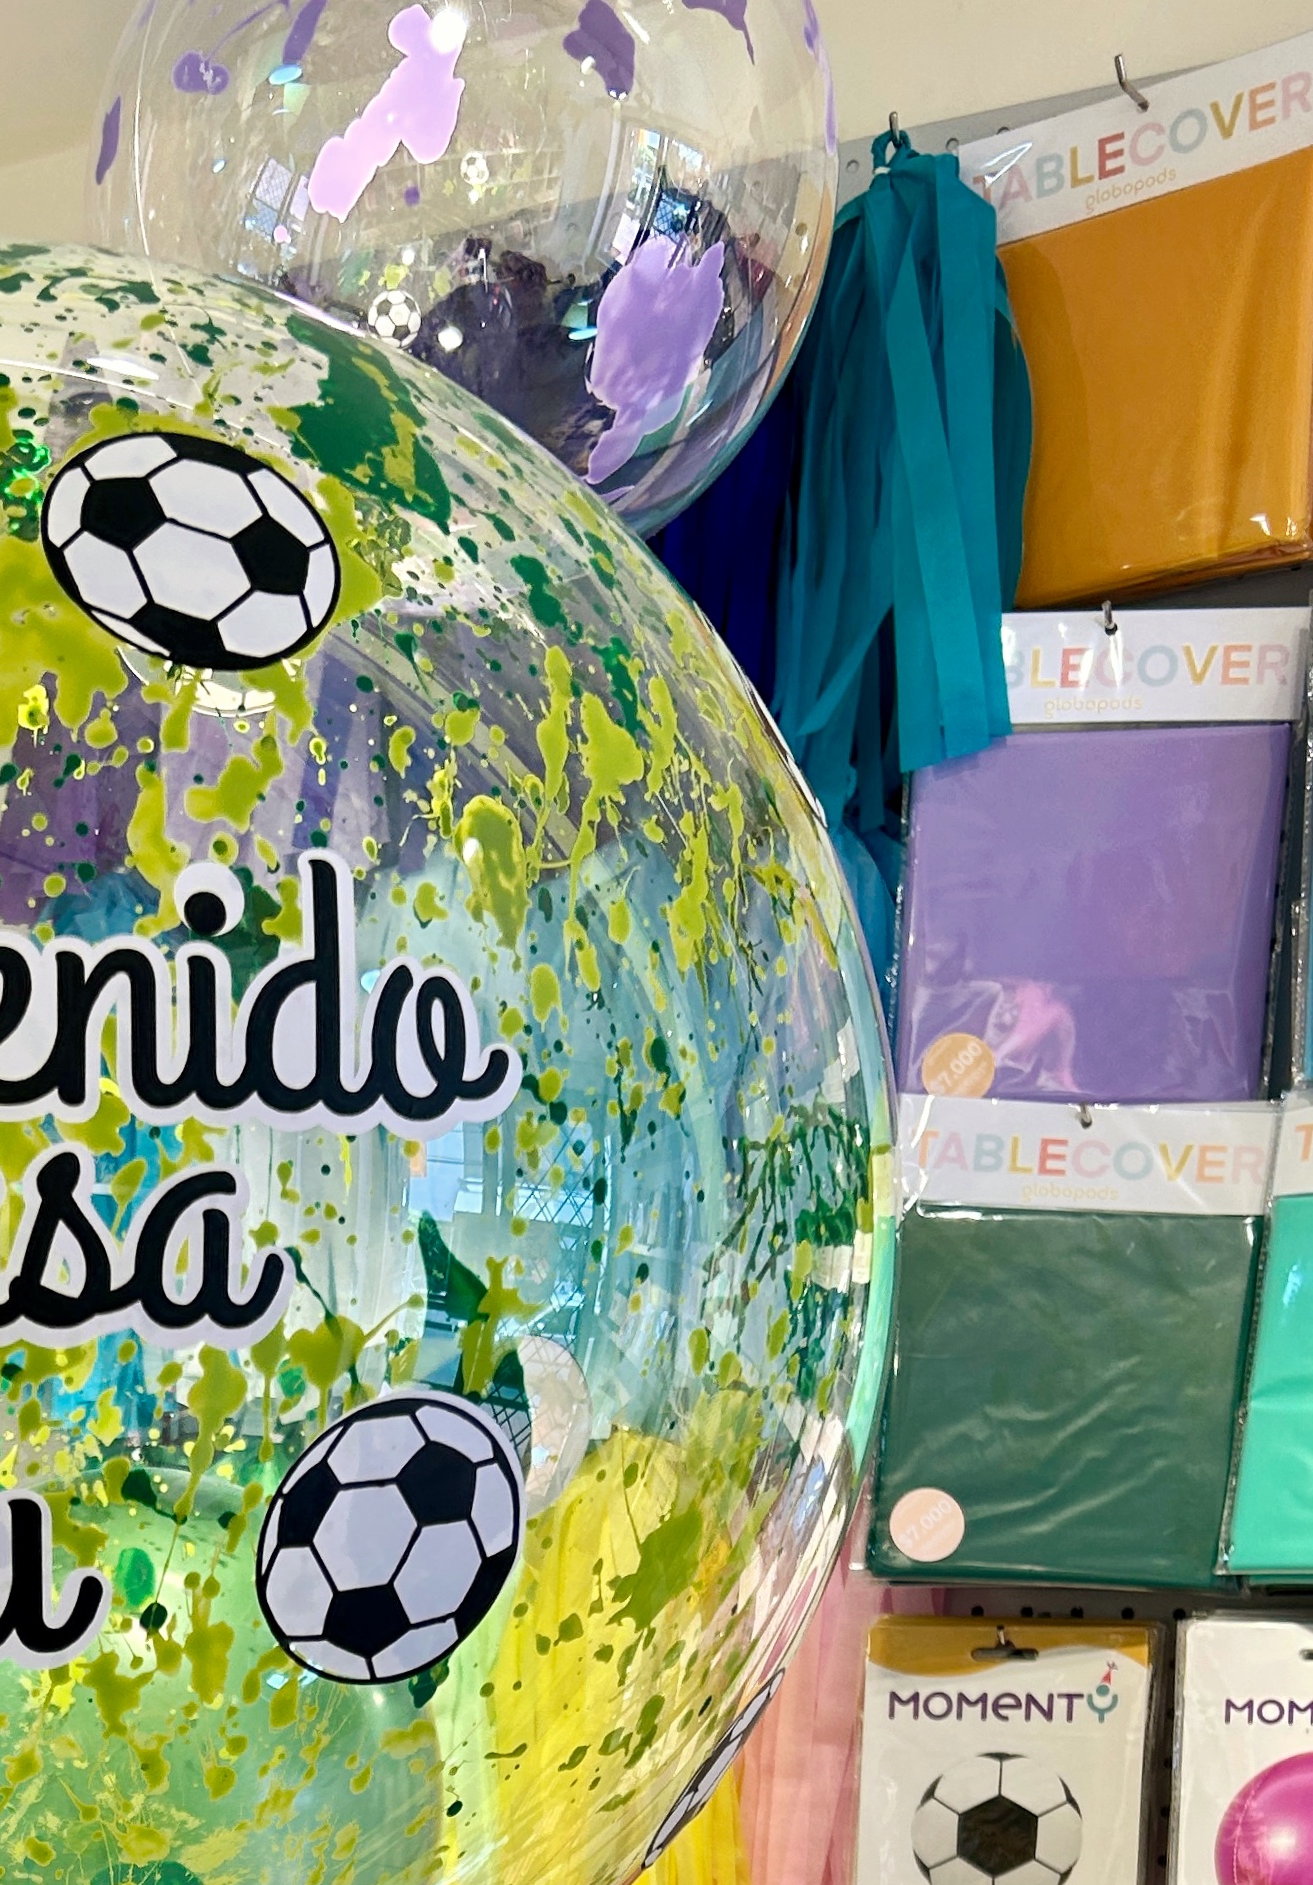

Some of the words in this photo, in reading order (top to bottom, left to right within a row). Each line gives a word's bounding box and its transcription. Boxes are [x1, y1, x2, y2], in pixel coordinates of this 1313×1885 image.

[973, 71, 1313, 208] TABLECOVER
[1085, 166, 1178, 215] globopods
[1004, 643, 1289, 690] BLECOVER
[1044, 695, 1144, 721] globopods
[915, 1128, 1264, 1188] TABLECOVER
[1021, 1181, 1119, 1202] globopods
